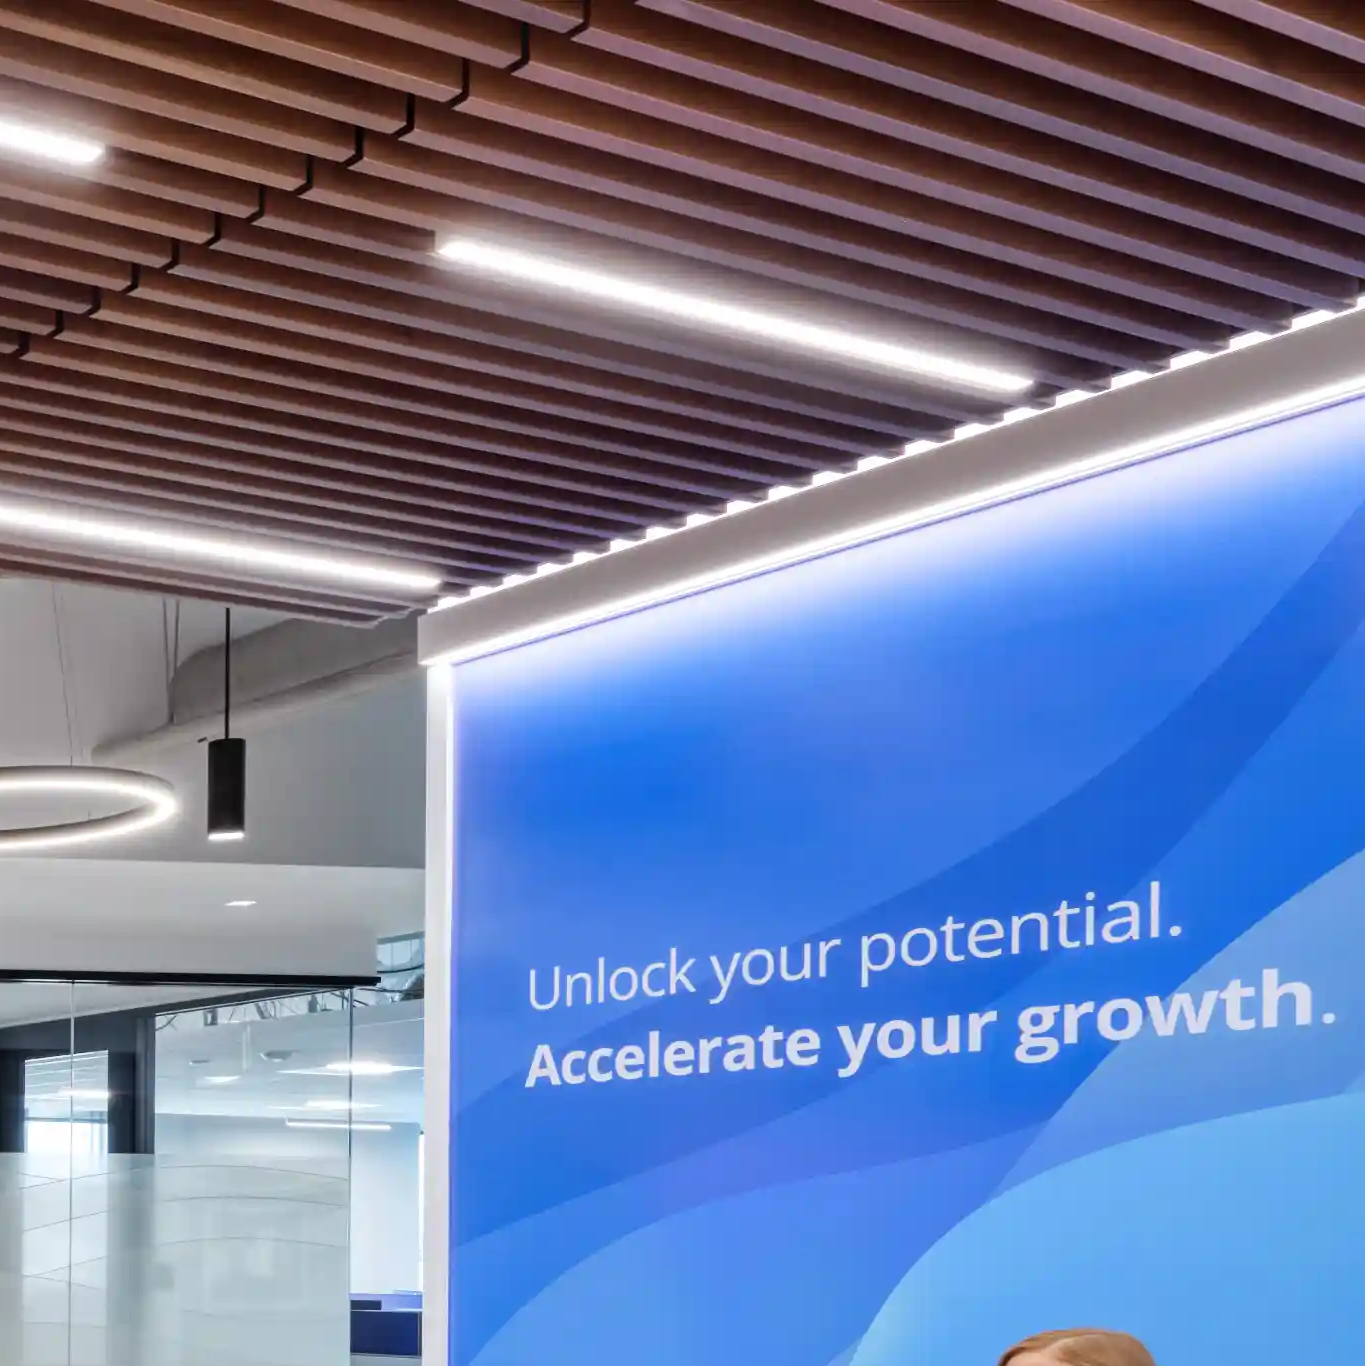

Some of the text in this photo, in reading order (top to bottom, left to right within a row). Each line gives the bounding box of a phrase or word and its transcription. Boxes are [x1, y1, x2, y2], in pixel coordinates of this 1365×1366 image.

[529, 881, 1182, 1010] Unlock your potential.
[524, 967, 1336, 1088] Accelerate your growth.
